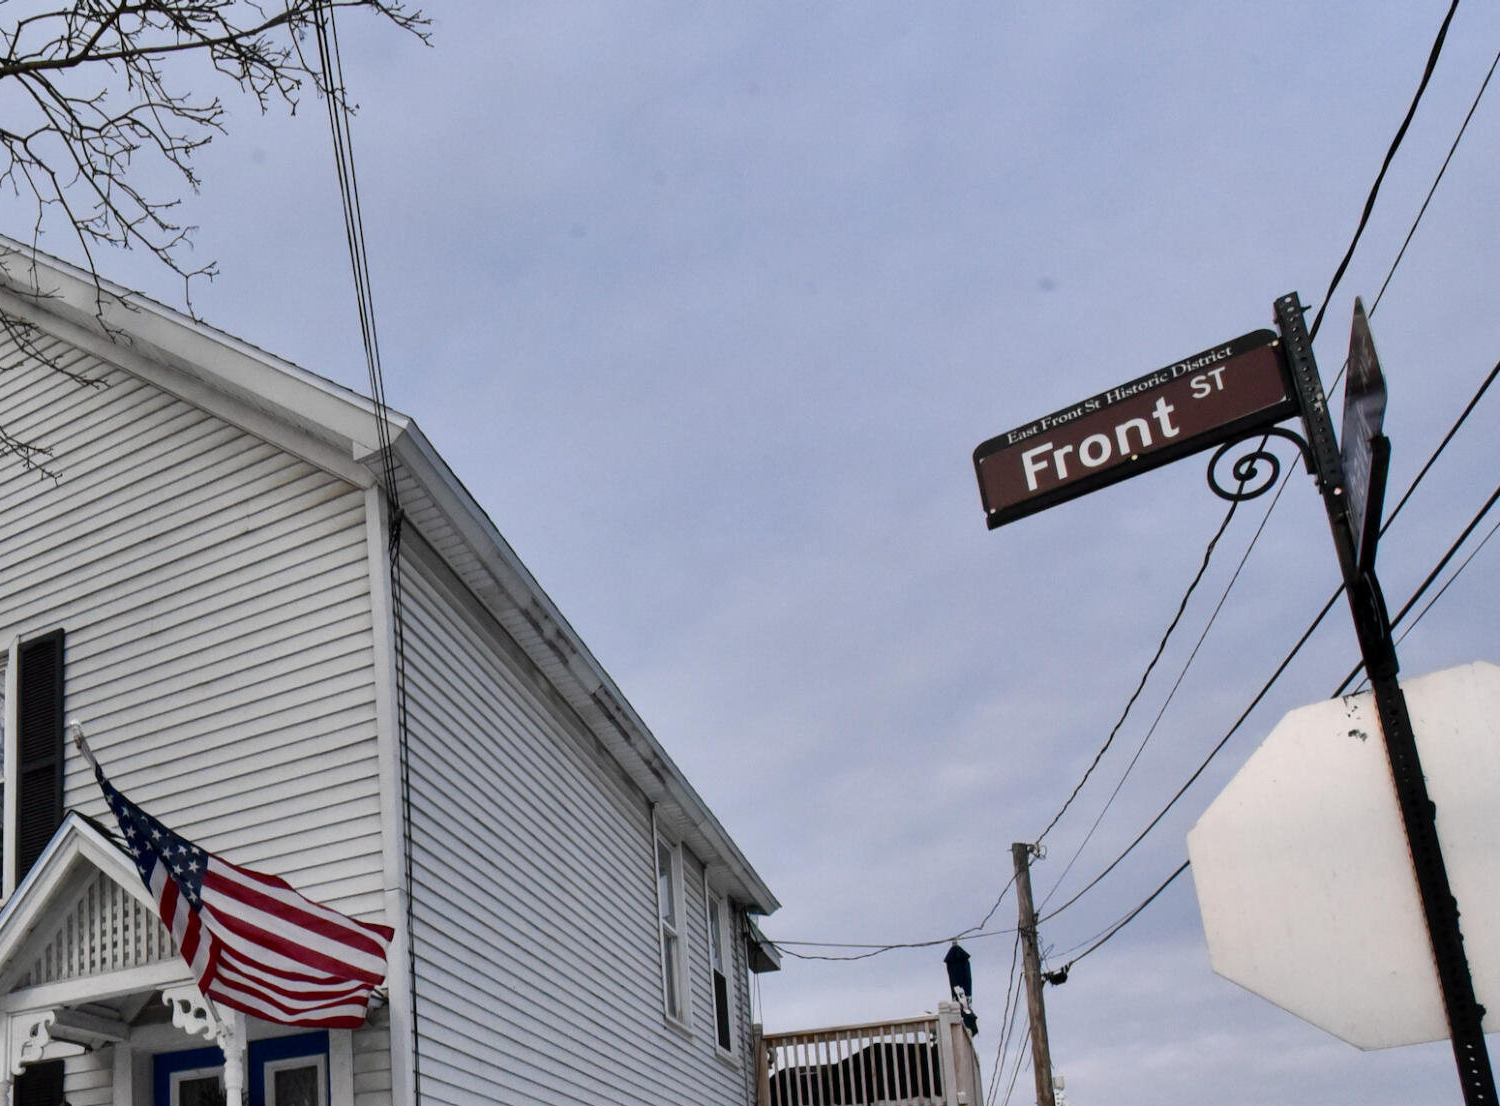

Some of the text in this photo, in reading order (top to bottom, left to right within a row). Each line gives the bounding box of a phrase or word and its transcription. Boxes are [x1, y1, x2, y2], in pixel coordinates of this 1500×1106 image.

[1007, 346, 1233, 445] East Front St Historic District
[1021, 366, 1227, 491] Front ST
